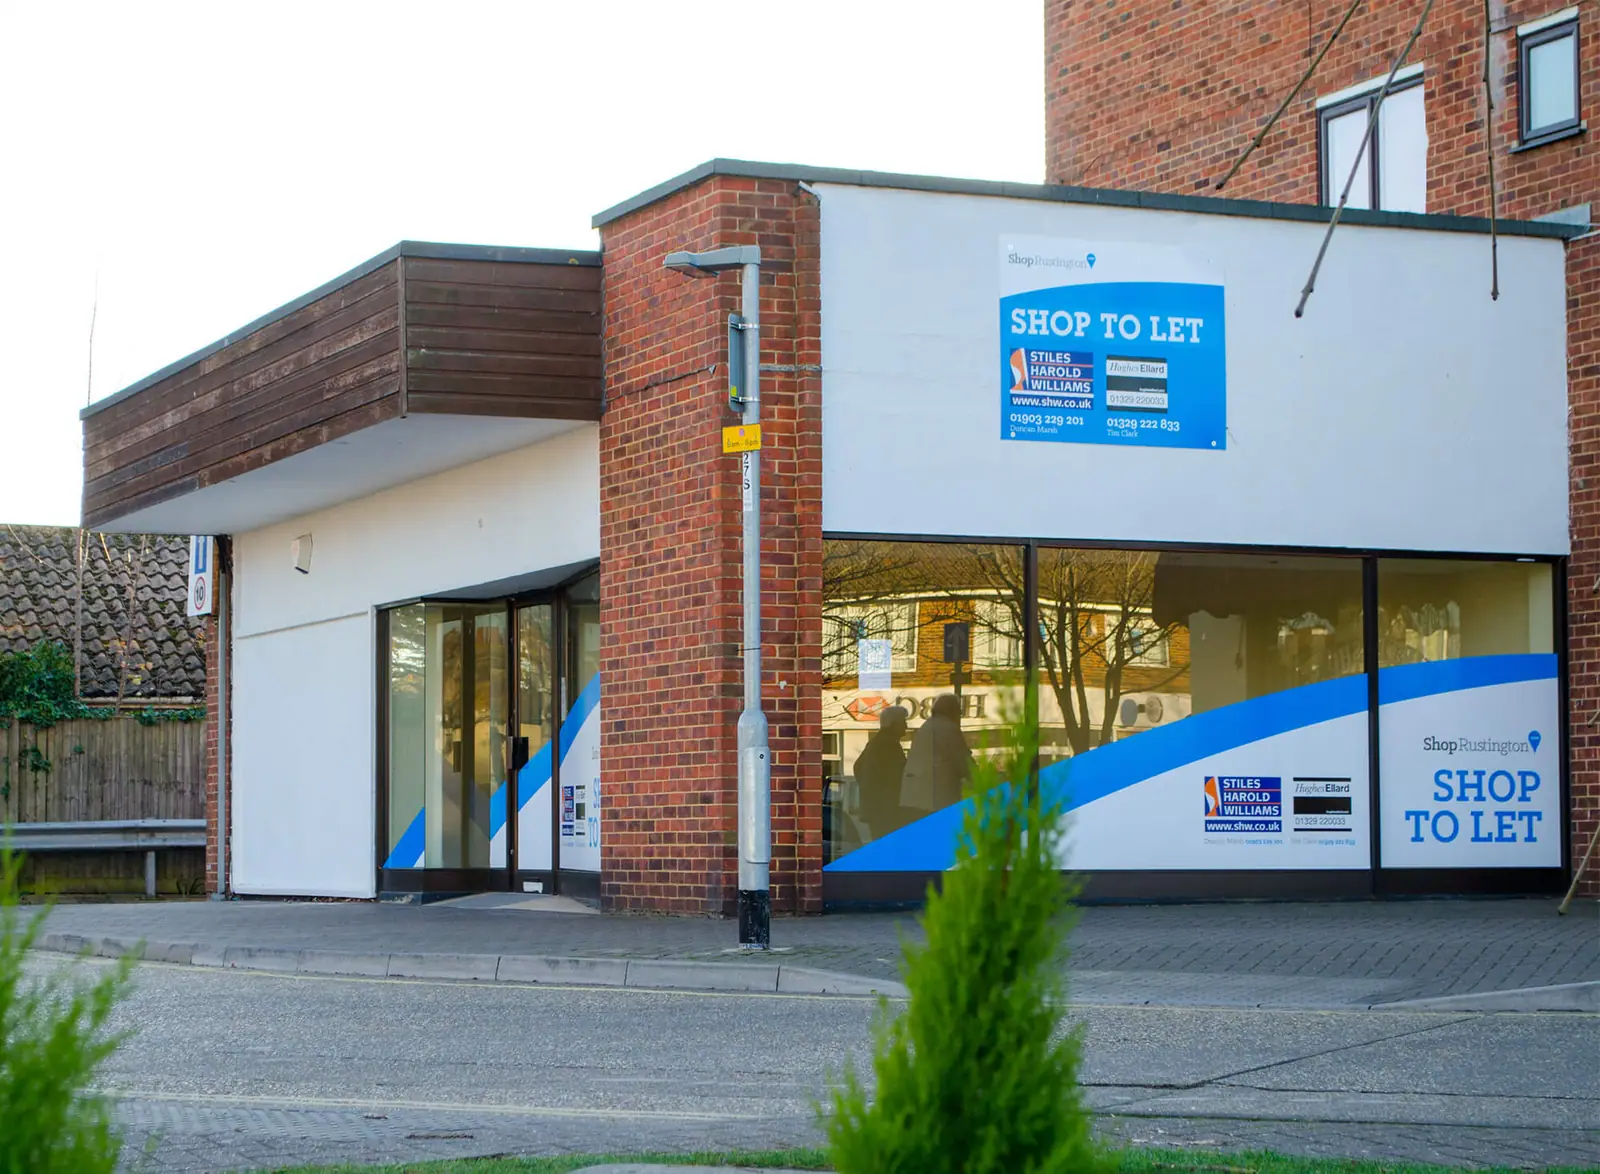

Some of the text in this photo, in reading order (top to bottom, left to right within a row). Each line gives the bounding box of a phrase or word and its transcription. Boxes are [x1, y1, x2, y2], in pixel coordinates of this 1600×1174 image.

[1011, 307, 1204, 343] SHOP TO LET
[1030, 351, 1071, 364] STILES
[1030, 365, 1081, 378] HAROLD
[1031, 379, 1091, 393] WILLIAMS
[1012, 396, 1091, 409] www.shw.co.uk
[1110, 395, 1134, 404] 01329
[1010, 413, 1084, 426] 01903 229 201
[1107, 418, 1180, 432] 01329 222 833
[196, 585, 204, 602] 10
[1223, 778, 1261, 789] STILES
[1433, 769, 1541, 803] SHOP
[1223, 792, 1271, 802] HAROLD
[1224, 805, 1280, 816] WILLIAMS
[1206, 821, 1280, 831] www.shw.co.uk
[1295, 817, 1318, 825] 01329
[1405, 809, 1543, 843] TO LET
